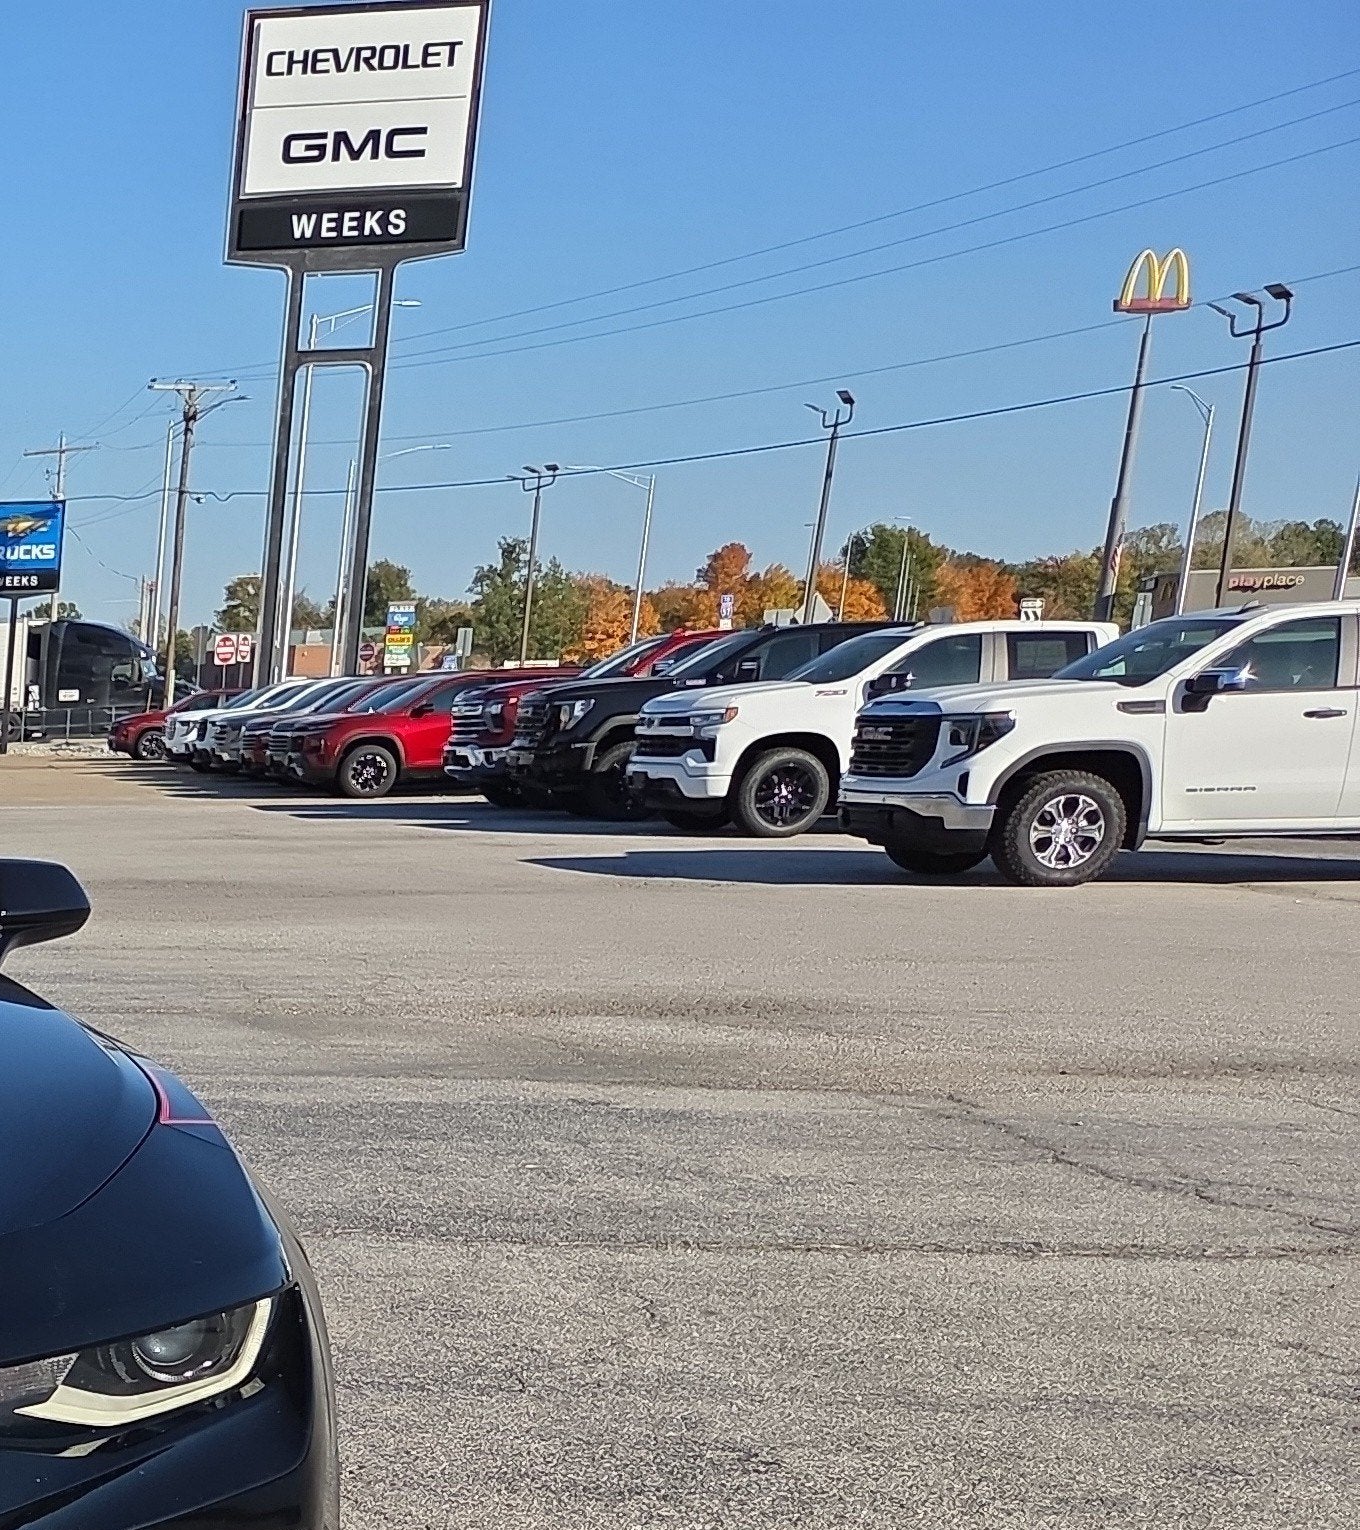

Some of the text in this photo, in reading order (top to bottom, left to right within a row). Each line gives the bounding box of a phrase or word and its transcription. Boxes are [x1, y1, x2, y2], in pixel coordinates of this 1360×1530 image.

[265, 40, 464, 77] CHEVROLET
[281, 126, 428, 165] GMC
[291, 208, 408, 240] WEEKS
[1228, 573, 1306, 590] playplace
